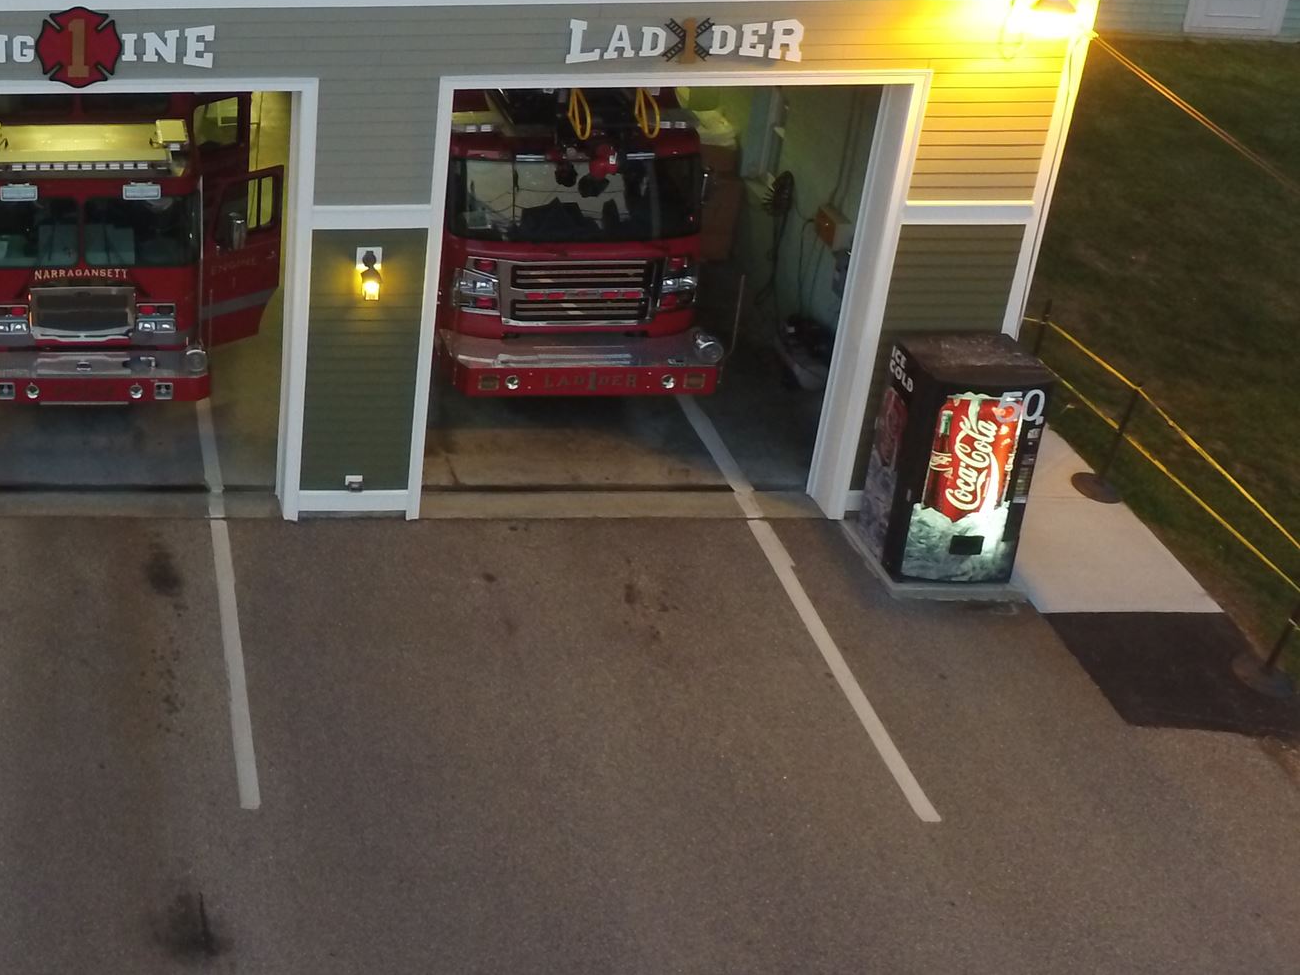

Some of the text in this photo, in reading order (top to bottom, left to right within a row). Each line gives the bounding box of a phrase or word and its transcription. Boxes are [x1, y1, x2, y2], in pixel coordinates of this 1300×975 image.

[34, 268, 128, 281] NARRAGANSETT
[891, 345, 907, 369] ICE
[889, 359, 913, 393] COLD
